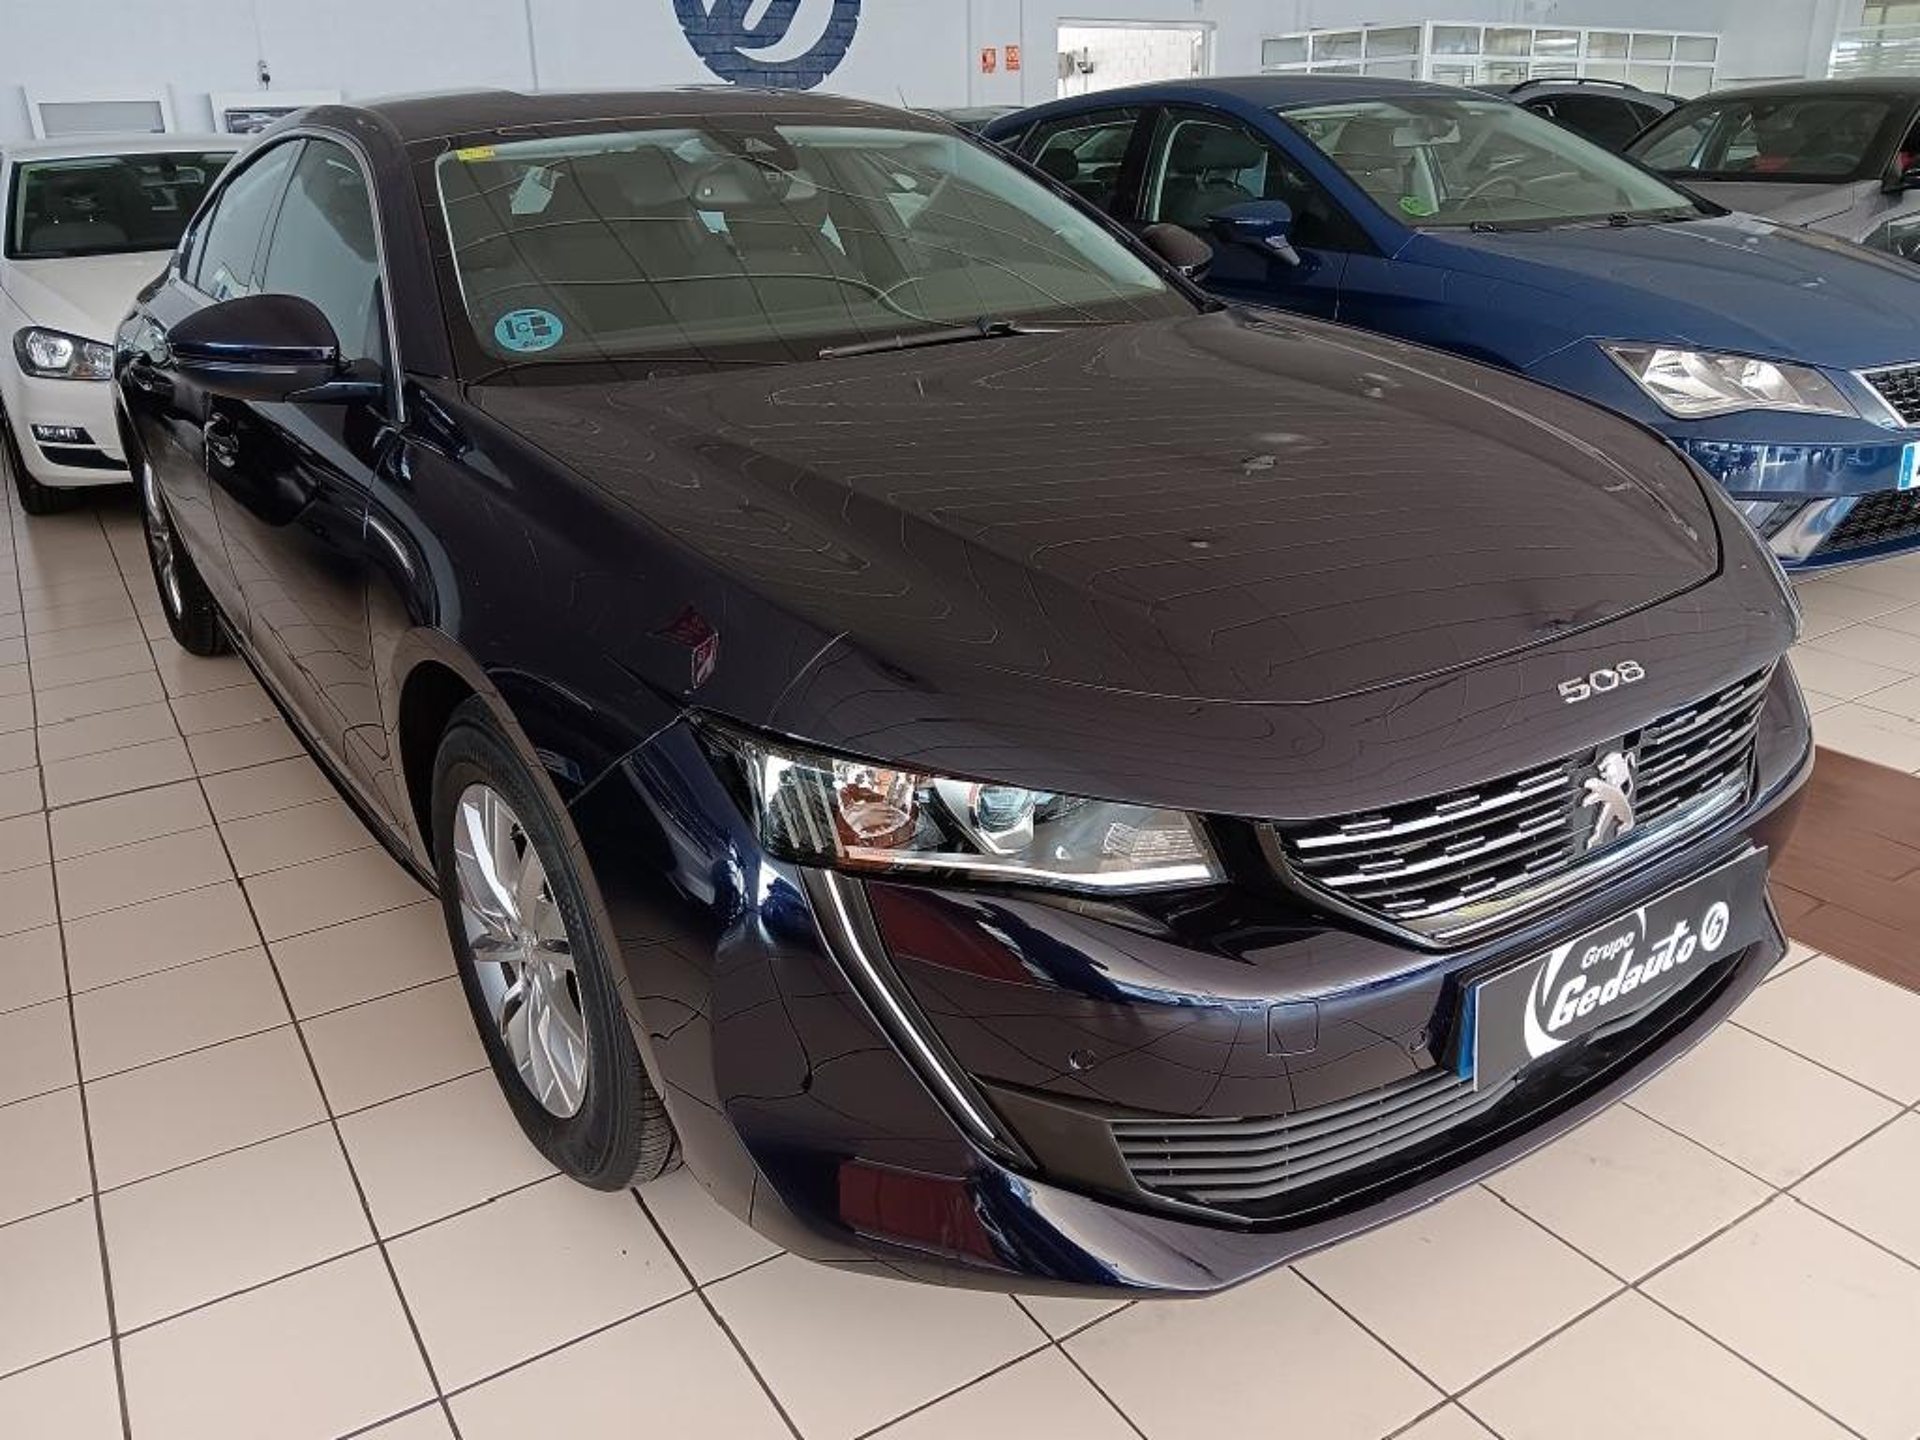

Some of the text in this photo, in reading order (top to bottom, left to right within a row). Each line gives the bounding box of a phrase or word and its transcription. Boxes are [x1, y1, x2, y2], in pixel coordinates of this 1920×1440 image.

[1557, 660, 1645, 704] 508
[1581, 931, 1635, 970] Grupo
[1547, 918, 1697, 1032] Gedauto
